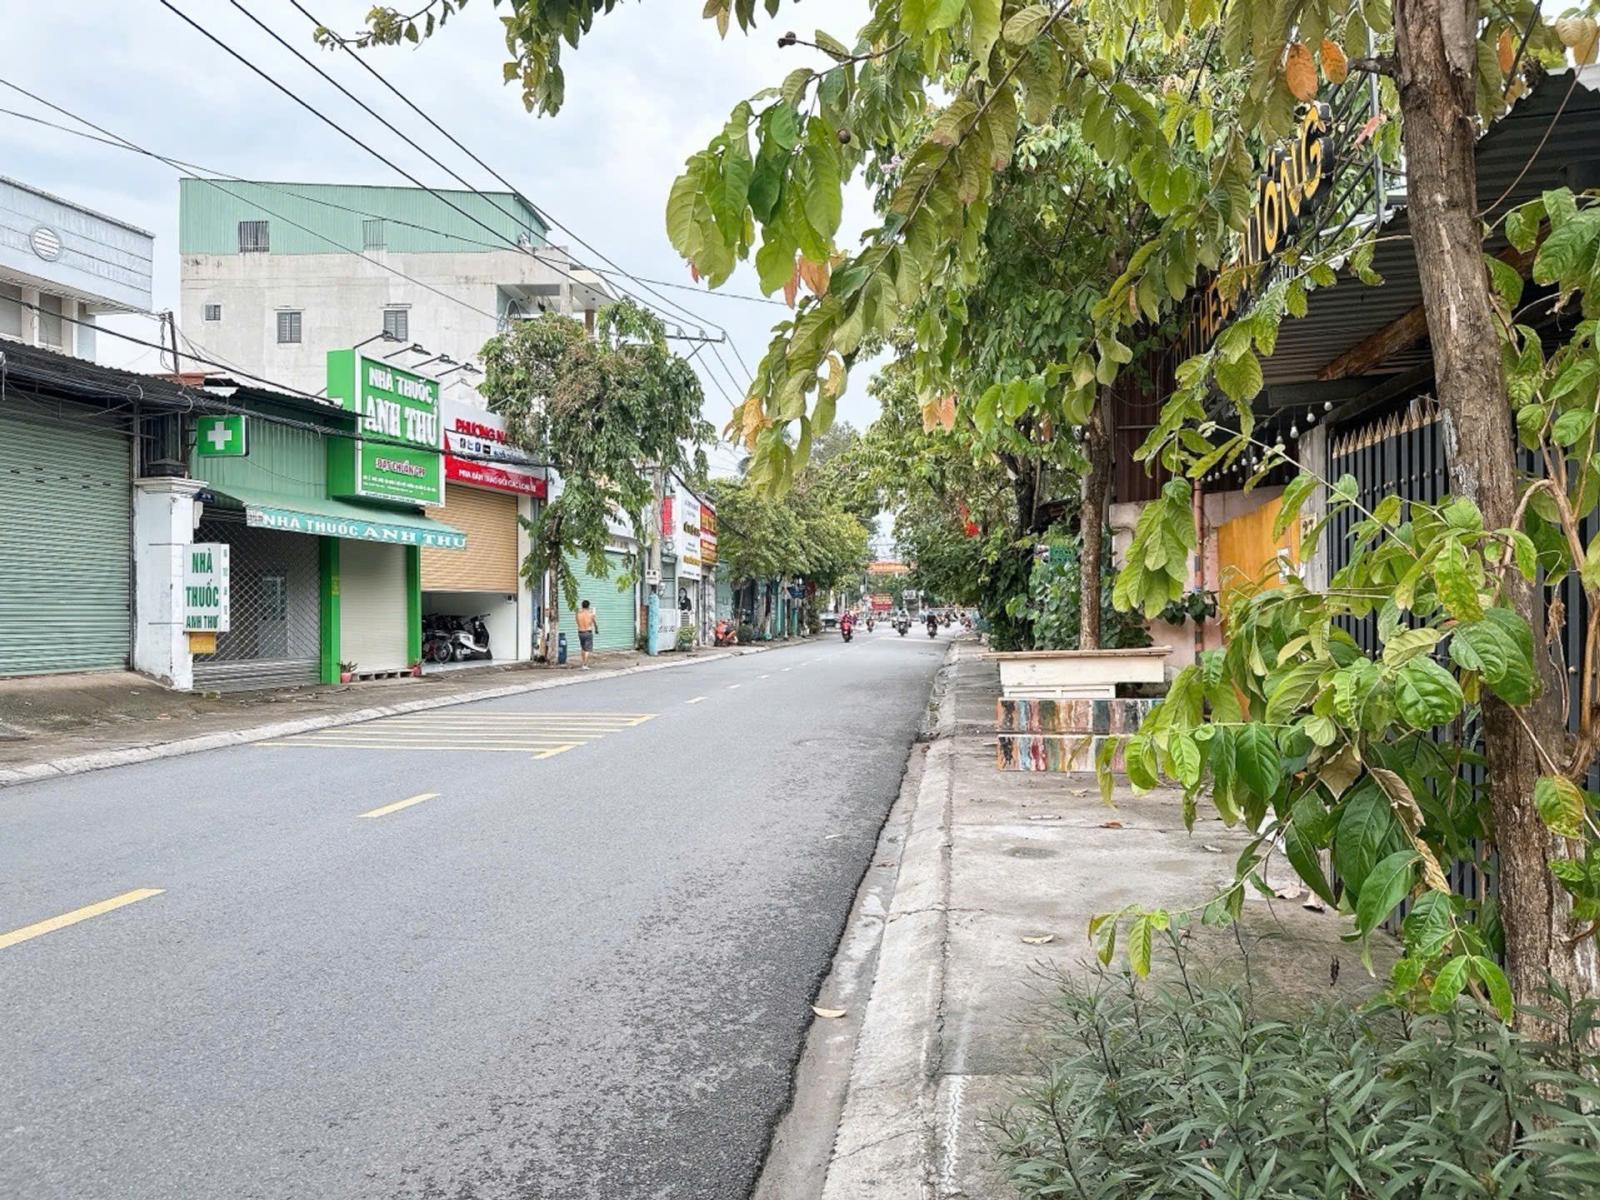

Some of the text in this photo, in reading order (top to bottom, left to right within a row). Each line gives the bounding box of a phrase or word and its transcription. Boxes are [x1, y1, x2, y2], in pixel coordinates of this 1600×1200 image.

[369, 367, 433, 404] NHÀ THUỐC
[364, 395, 438, 446] ANH THƯ
[456, 419, 495, 441] PHƯƠNG
[364, 526, 416, 541] ANH
[192, 548, 213, 573] NHÀ
[186, 578, 219, 607] THUỐC
[186, 615, 219, 629] ANH THƯ
